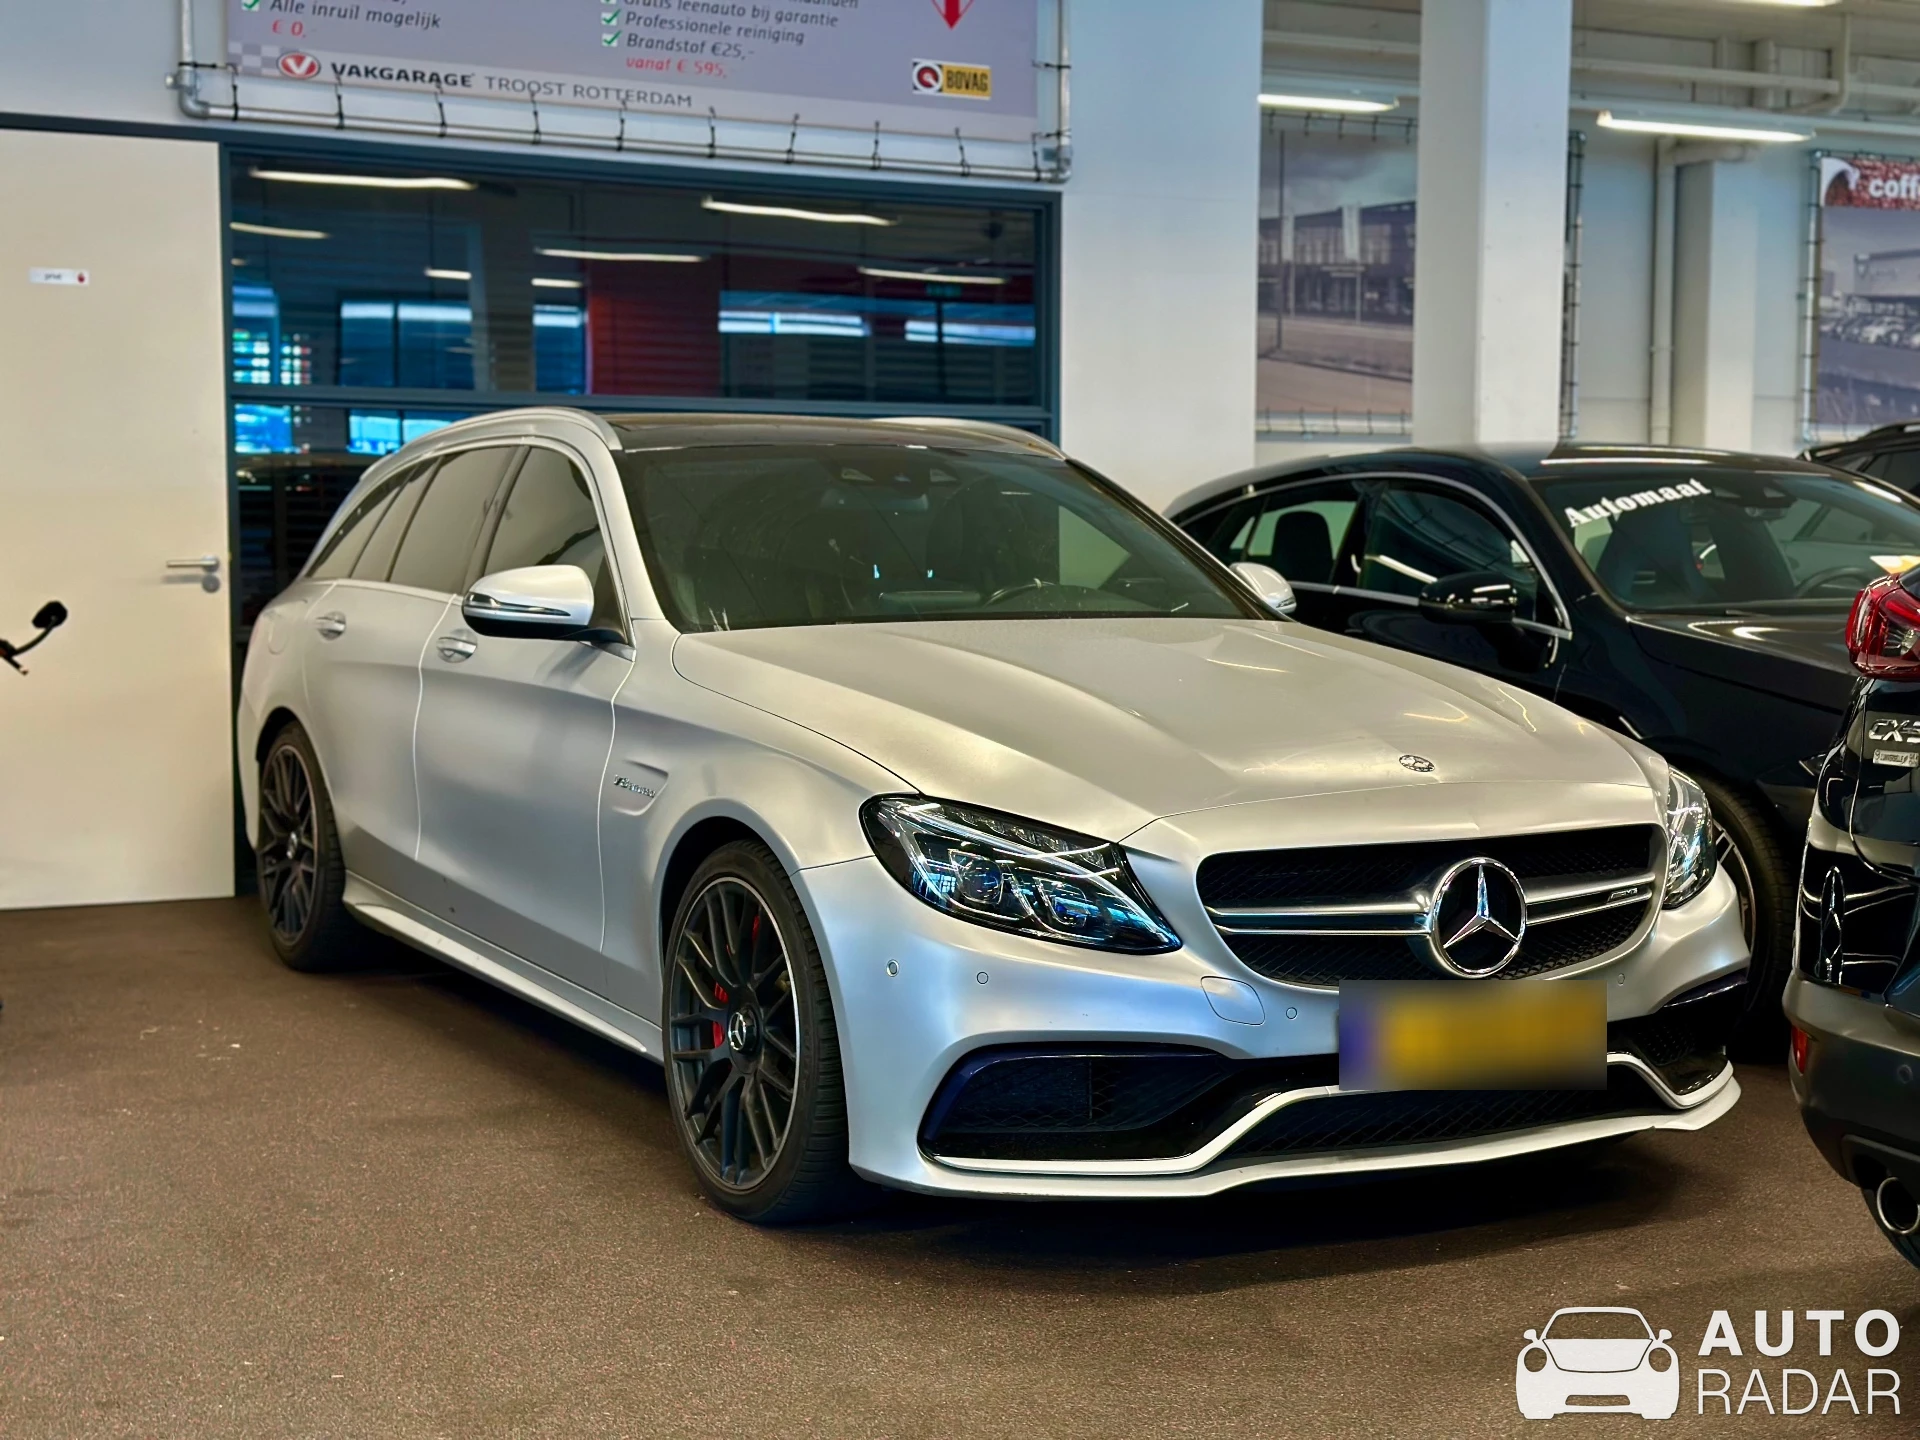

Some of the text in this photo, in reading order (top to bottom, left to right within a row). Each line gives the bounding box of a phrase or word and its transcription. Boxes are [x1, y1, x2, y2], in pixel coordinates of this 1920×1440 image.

[270, 0, 441, 30] Alle inruil mogelijk
[677, 0, 746, 18] leenauto
[752, 4, 770, 22] bij
[775, 10, 839, 28] garantie
[625, 11, 805, 46] Professionele reiniging
[626, 33, 755, 61] Brandstof €25,-
[626, 57, 671, 72] vanaf
[331, 62, 692, 108] VAKGARAGE TROOST ROTTERDAM
[946, 70, 989, 92] BOVAG
[1868, 173, 1920, 200] coff
[1564, 478, 1712, 528] Automaat
